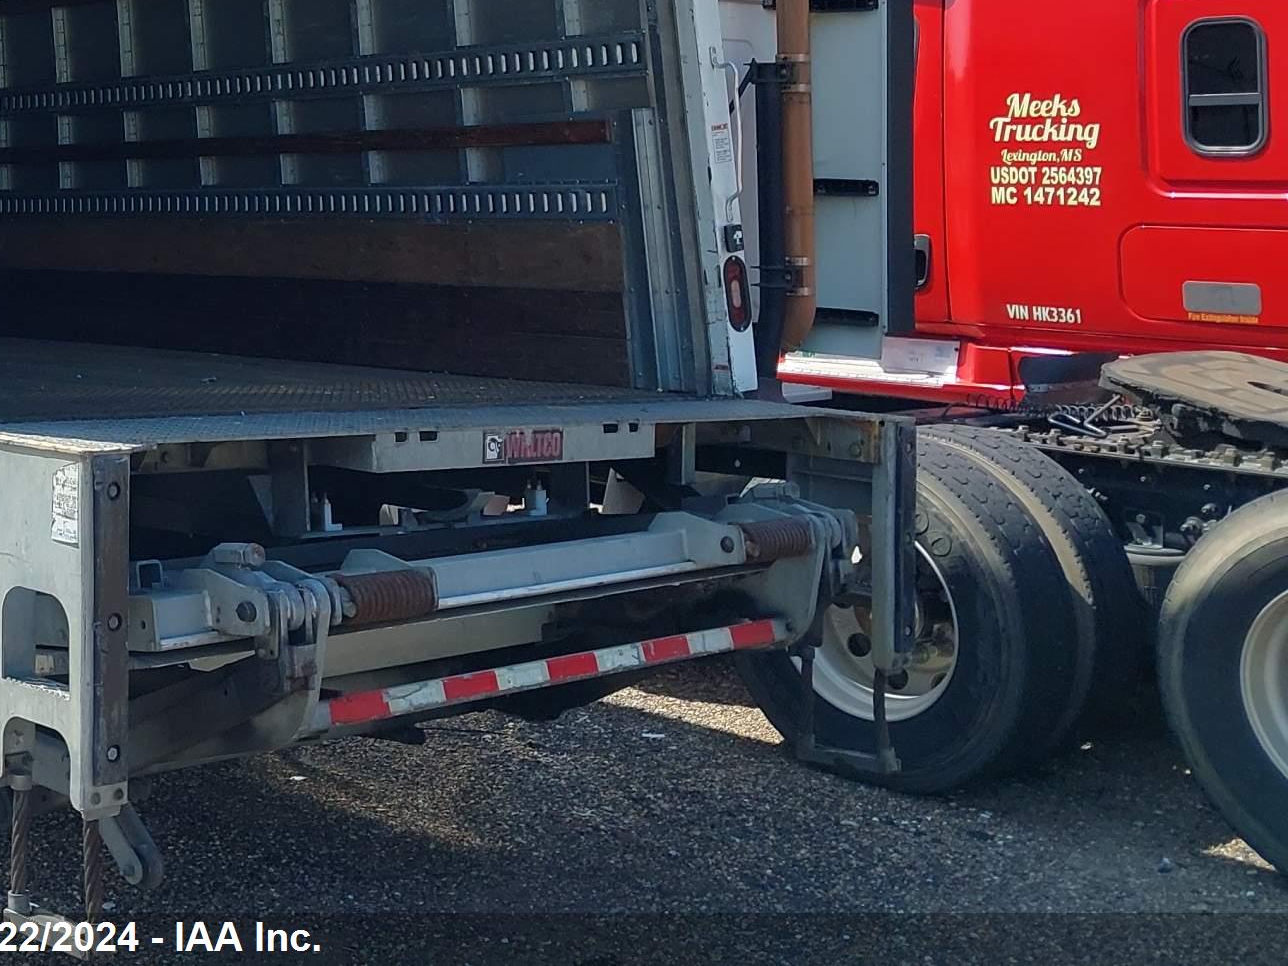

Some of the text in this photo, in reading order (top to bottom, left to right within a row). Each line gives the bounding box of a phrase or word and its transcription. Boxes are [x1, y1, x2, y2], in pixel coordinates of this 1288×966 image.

[1006, 93, 1081, 119] Meeks
[989, 117, 1100, 149] Trucking
[990, 167, 1102, 185] USDOT 2564397
[991, 187, 1101, 206] MC 1471242
[1006, 303, 1082, 324] VIN HK3361
